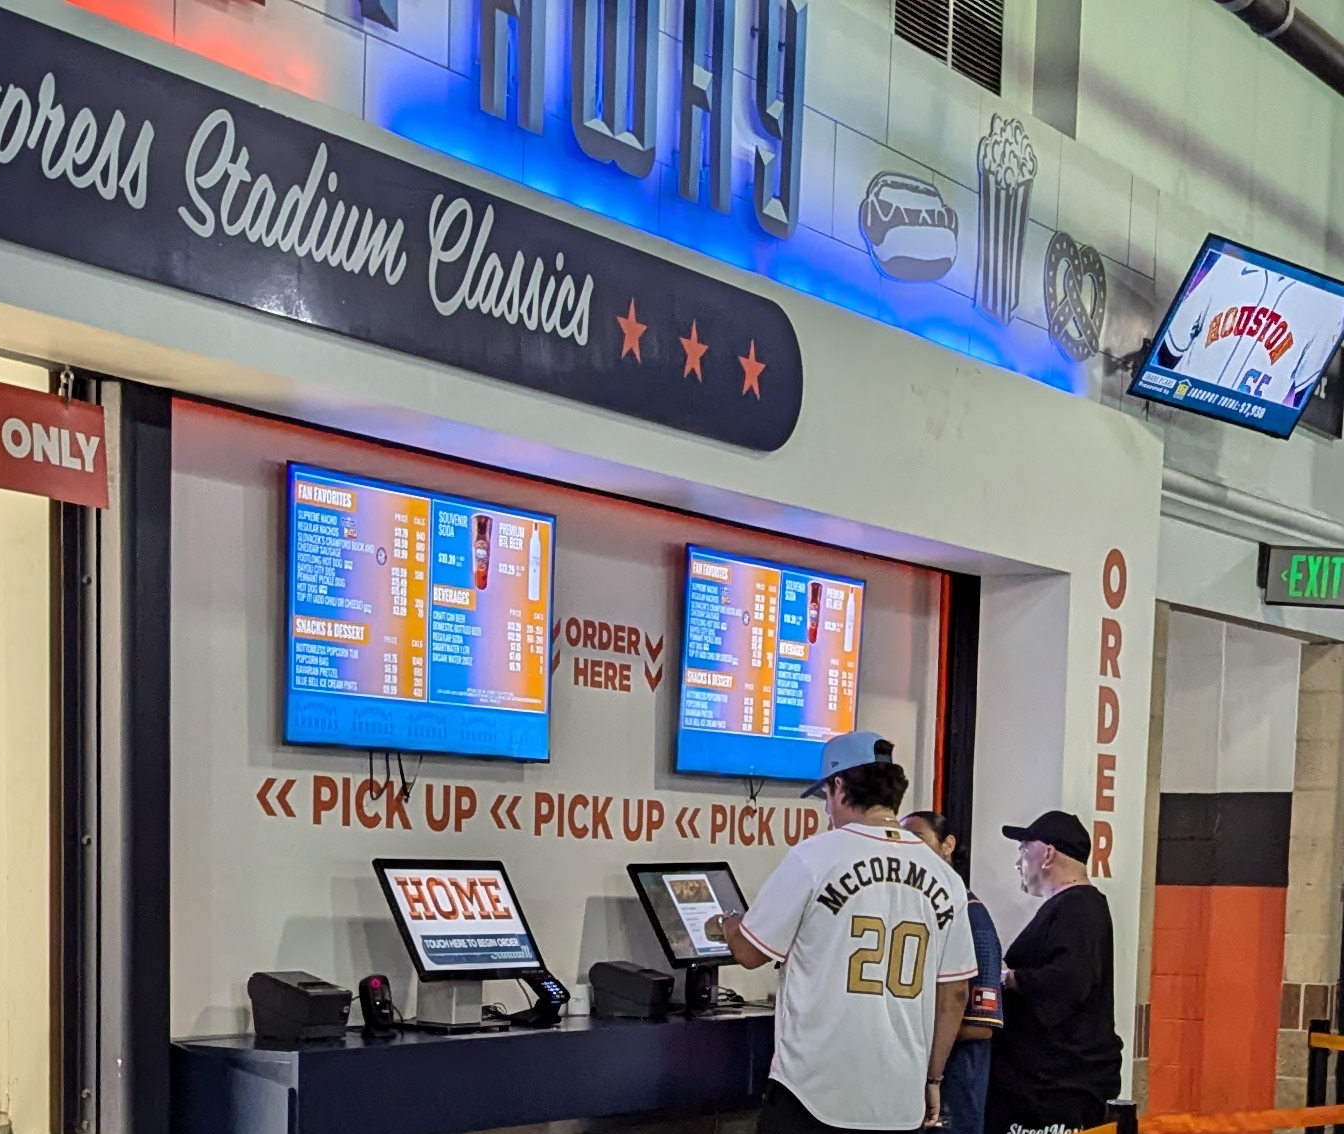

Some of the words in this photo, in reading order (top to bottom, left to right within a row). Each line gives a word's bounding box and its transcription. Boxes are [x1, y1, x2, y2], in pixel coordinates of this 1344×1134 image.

[178, 107, 406, 286] Stadium
[429, 192, 593, 346] Classics
[1, 418, 100, 473] ONLY
[298, 484, 312, 499] FAN
[314, 488, 352, 508] FAVORITES
[434, 586, 469, 605] BEVERAGES
[296, 619, 325, 635] SNACKS
[334, 624, 364, 640] DESSERT
[565, 622, 641, 656] ORDER
[572, 657, 633, 692] HERE
[1091, 548, 1127, 879] ORDER
[313, 774, 413, 830] PICK
[425, 784, 477, 834] UP
[534, 792, 613, 840] PICK
[623, 797, 666, 842] UP
[709, 803, 777, 847] PICK
[783, 806, 818, 847] UP
[394, 876, 513, 920] HOME
[424, 939, 450, 949] TOUCH
[450, 939, 467, 948] HERE
[467, 938, 478, 948] TO
[477, 938, 497, 948] BEGIN
[497, 938, 520, 947] ORDER
[847, 915, 930, 999] 20
